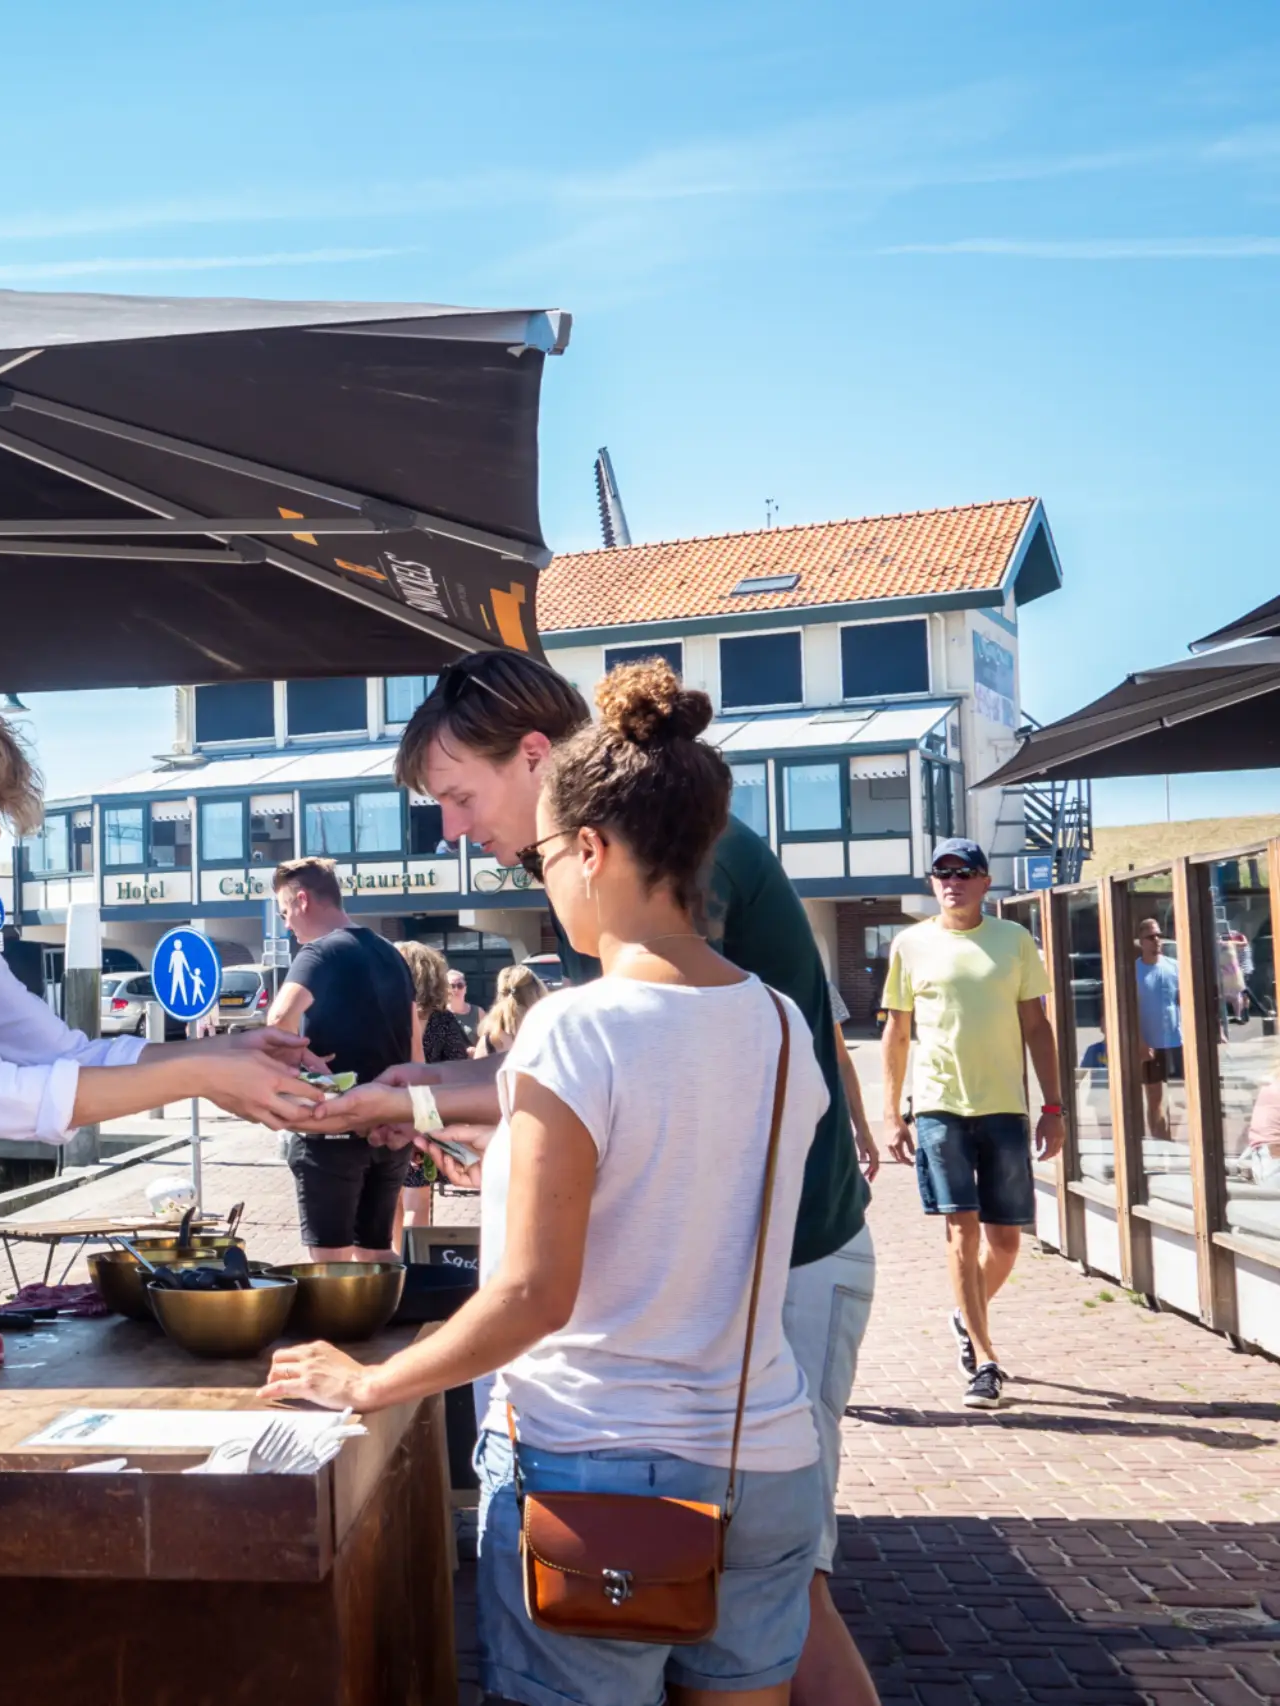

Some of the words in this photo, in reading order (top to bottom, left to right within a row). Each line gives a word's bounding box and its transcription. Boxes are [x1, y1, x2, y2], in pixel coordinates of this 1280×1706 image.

[116, 880, 165, 900] Hotel
[219, 876, 264, 896] Cafe
[339, 868, 437, 890] staurant
